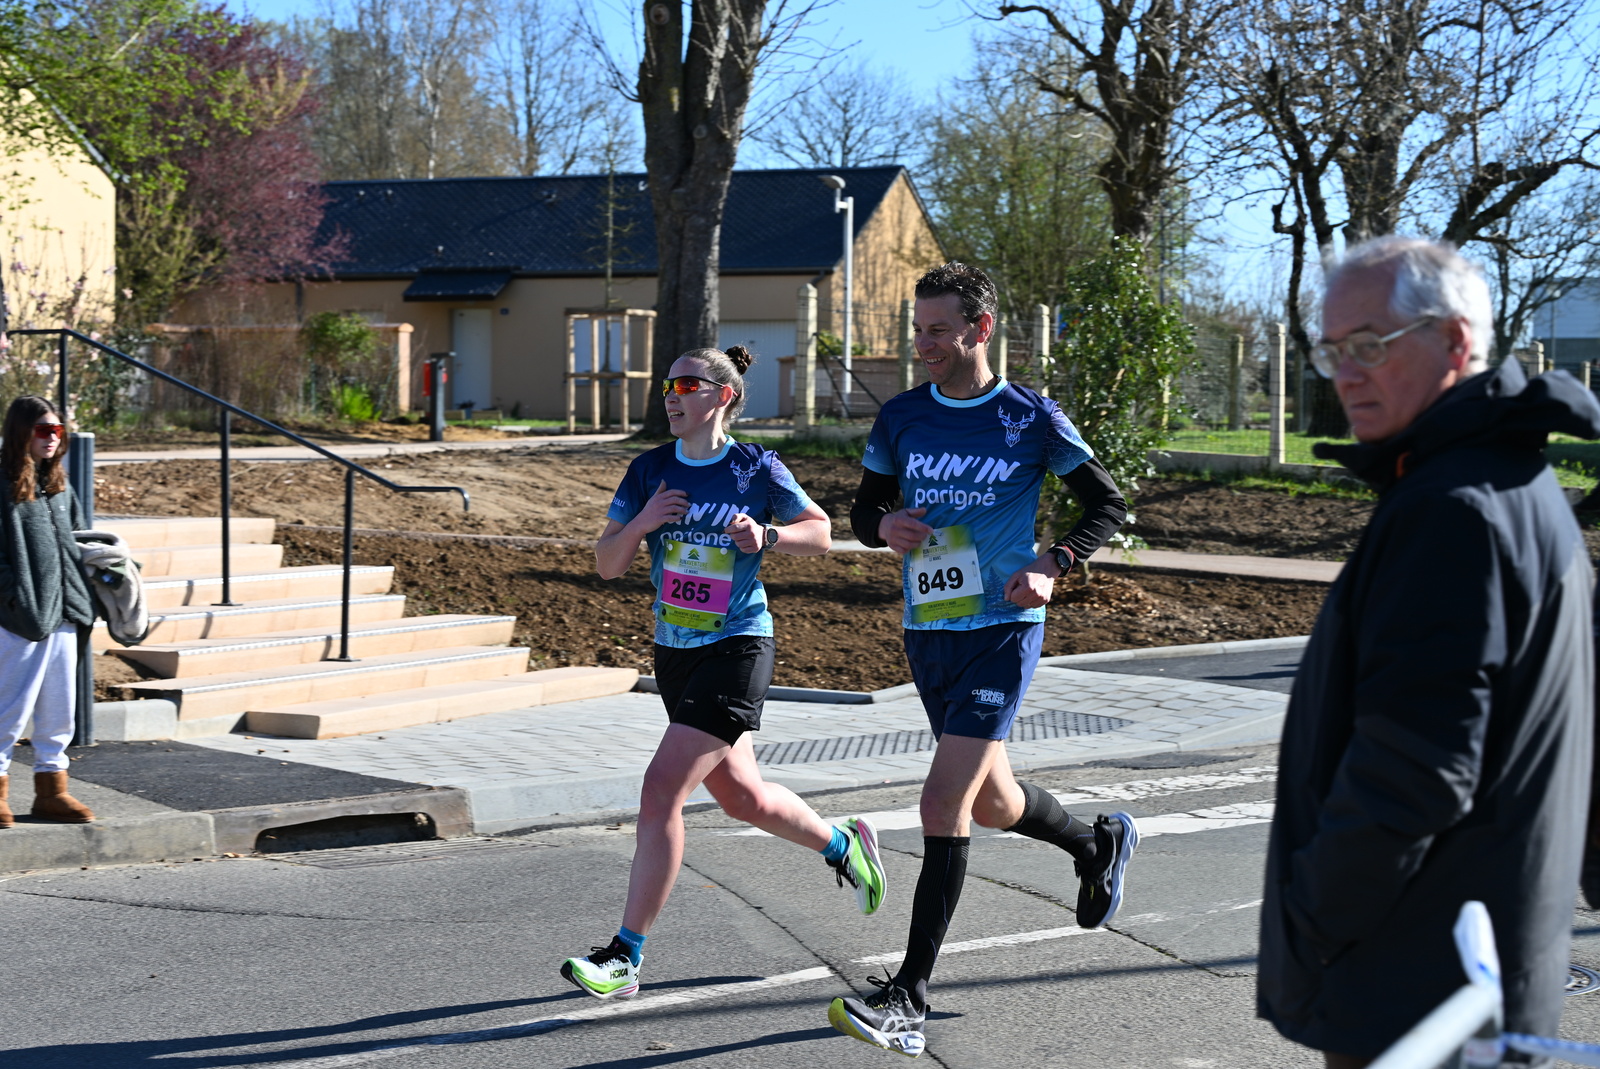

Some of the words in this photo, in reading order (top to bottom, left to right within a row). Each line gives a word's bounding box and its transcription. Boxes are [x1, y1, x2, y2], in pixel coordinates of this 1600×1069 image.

[905, 452, 1021, 485] RUN'IN
[914, 484, 997, 511] parigné
[671, 578, 711, 604] 265
[917, 566, 964, 595] 849
[610, 968, 628, 980] HOKA
